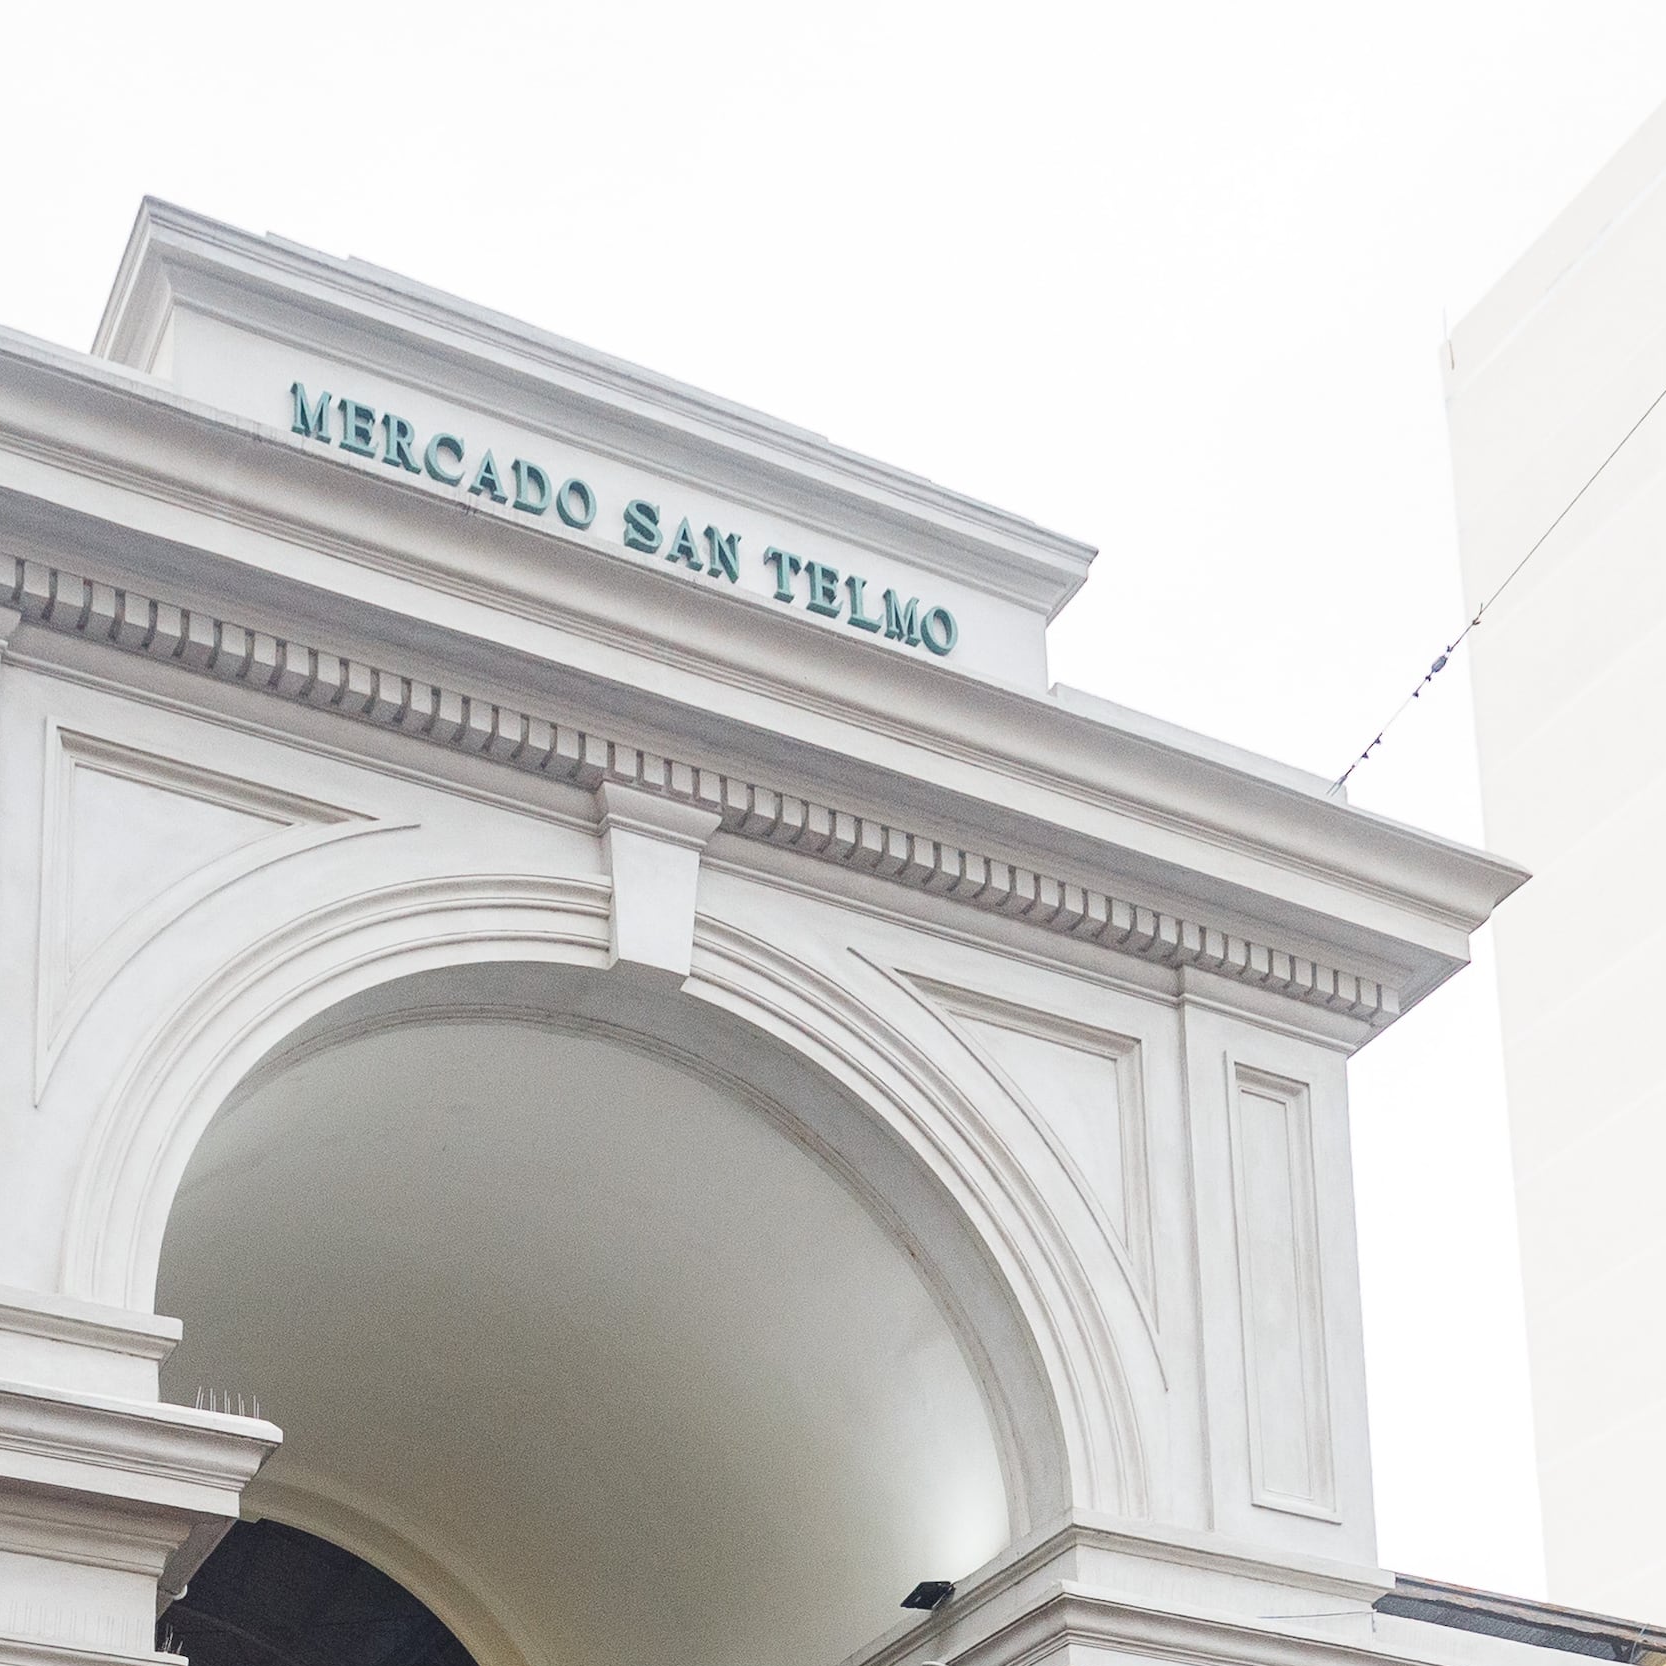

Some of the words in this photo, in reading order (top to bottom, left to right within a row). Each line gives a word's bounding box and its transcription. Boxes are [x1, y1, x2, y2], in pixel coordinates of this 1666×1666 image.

[290, 382, 596, 530] MERCADO
[623, 500, 742, 583] SAN
[763, 546, 959, 656] TELMO
